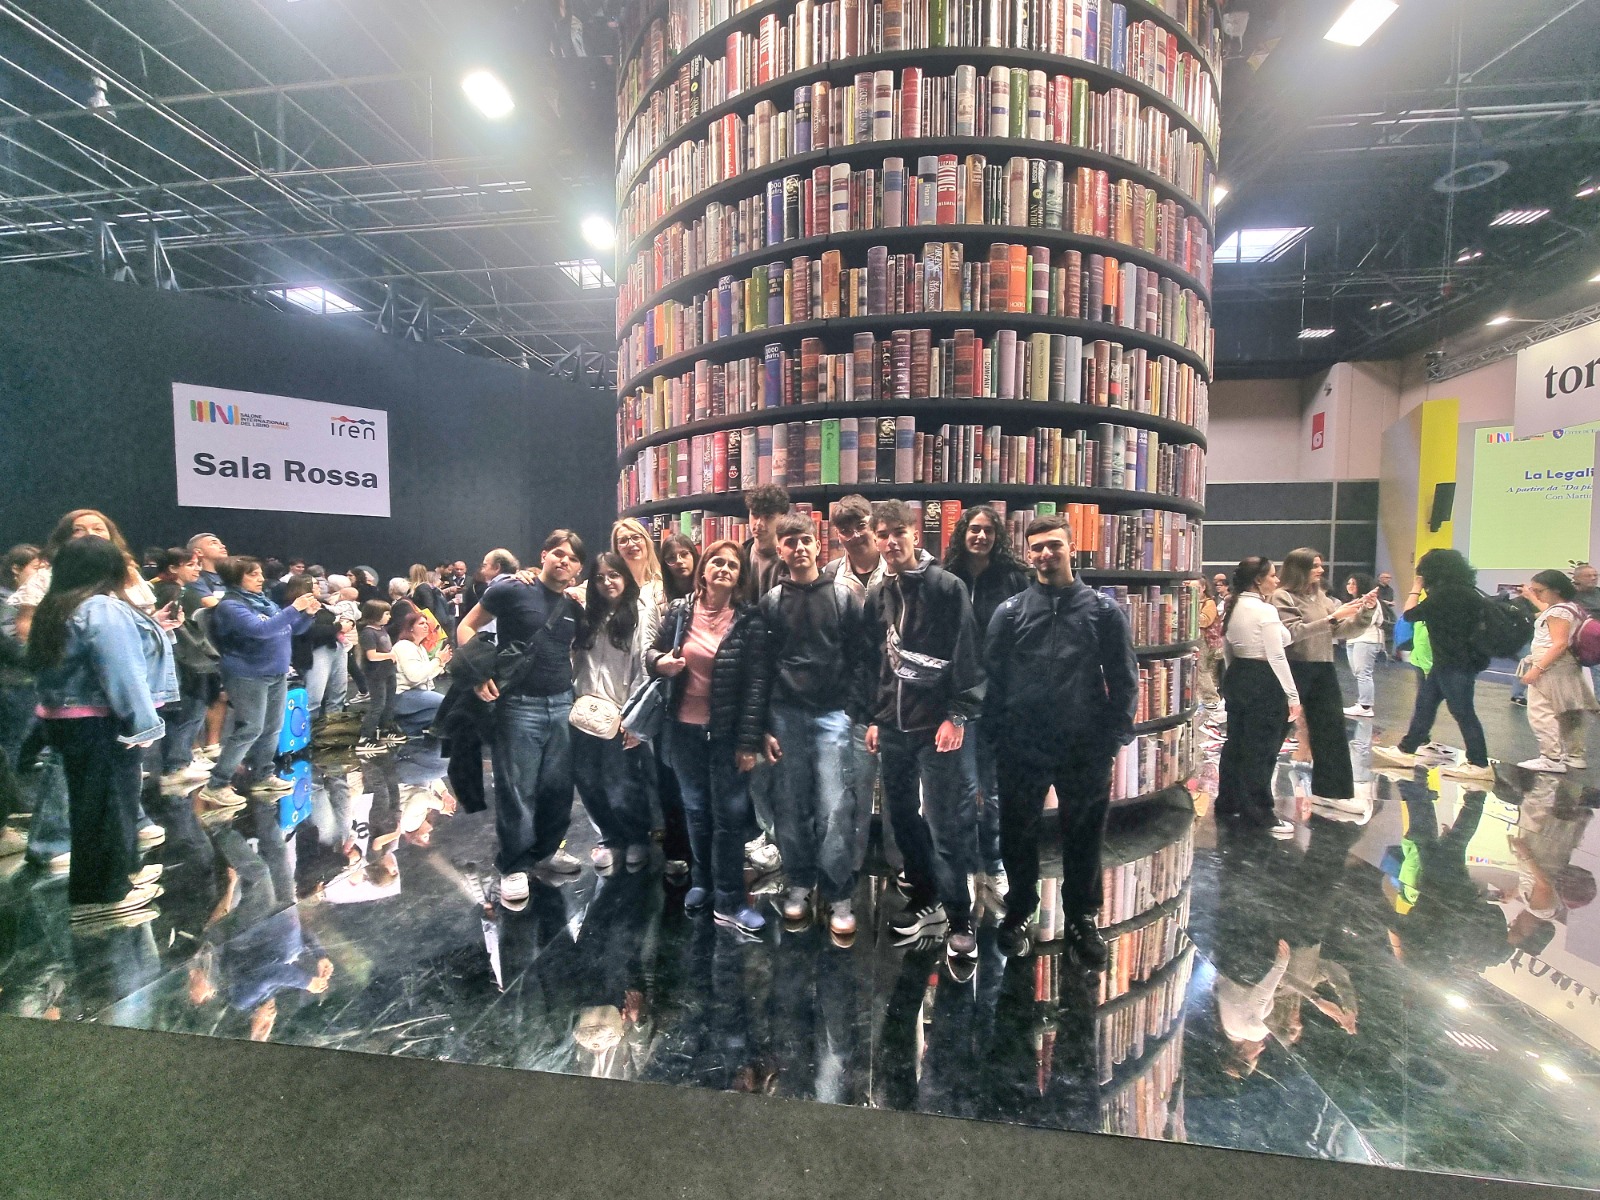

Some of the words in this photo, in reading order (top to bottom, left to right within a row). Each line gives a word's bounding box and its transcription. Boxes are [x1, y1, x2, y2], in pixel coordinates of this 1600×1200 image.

[937, 165, 957, 192] KING
[1030, 204, 1038, 226] BRIAN
[193, 452, 271, 480] Sala
[284, 459, 378, 489] Rossa
[1525, 471, 1542, 480] La
[1515, 486, 1545, 494] partire
